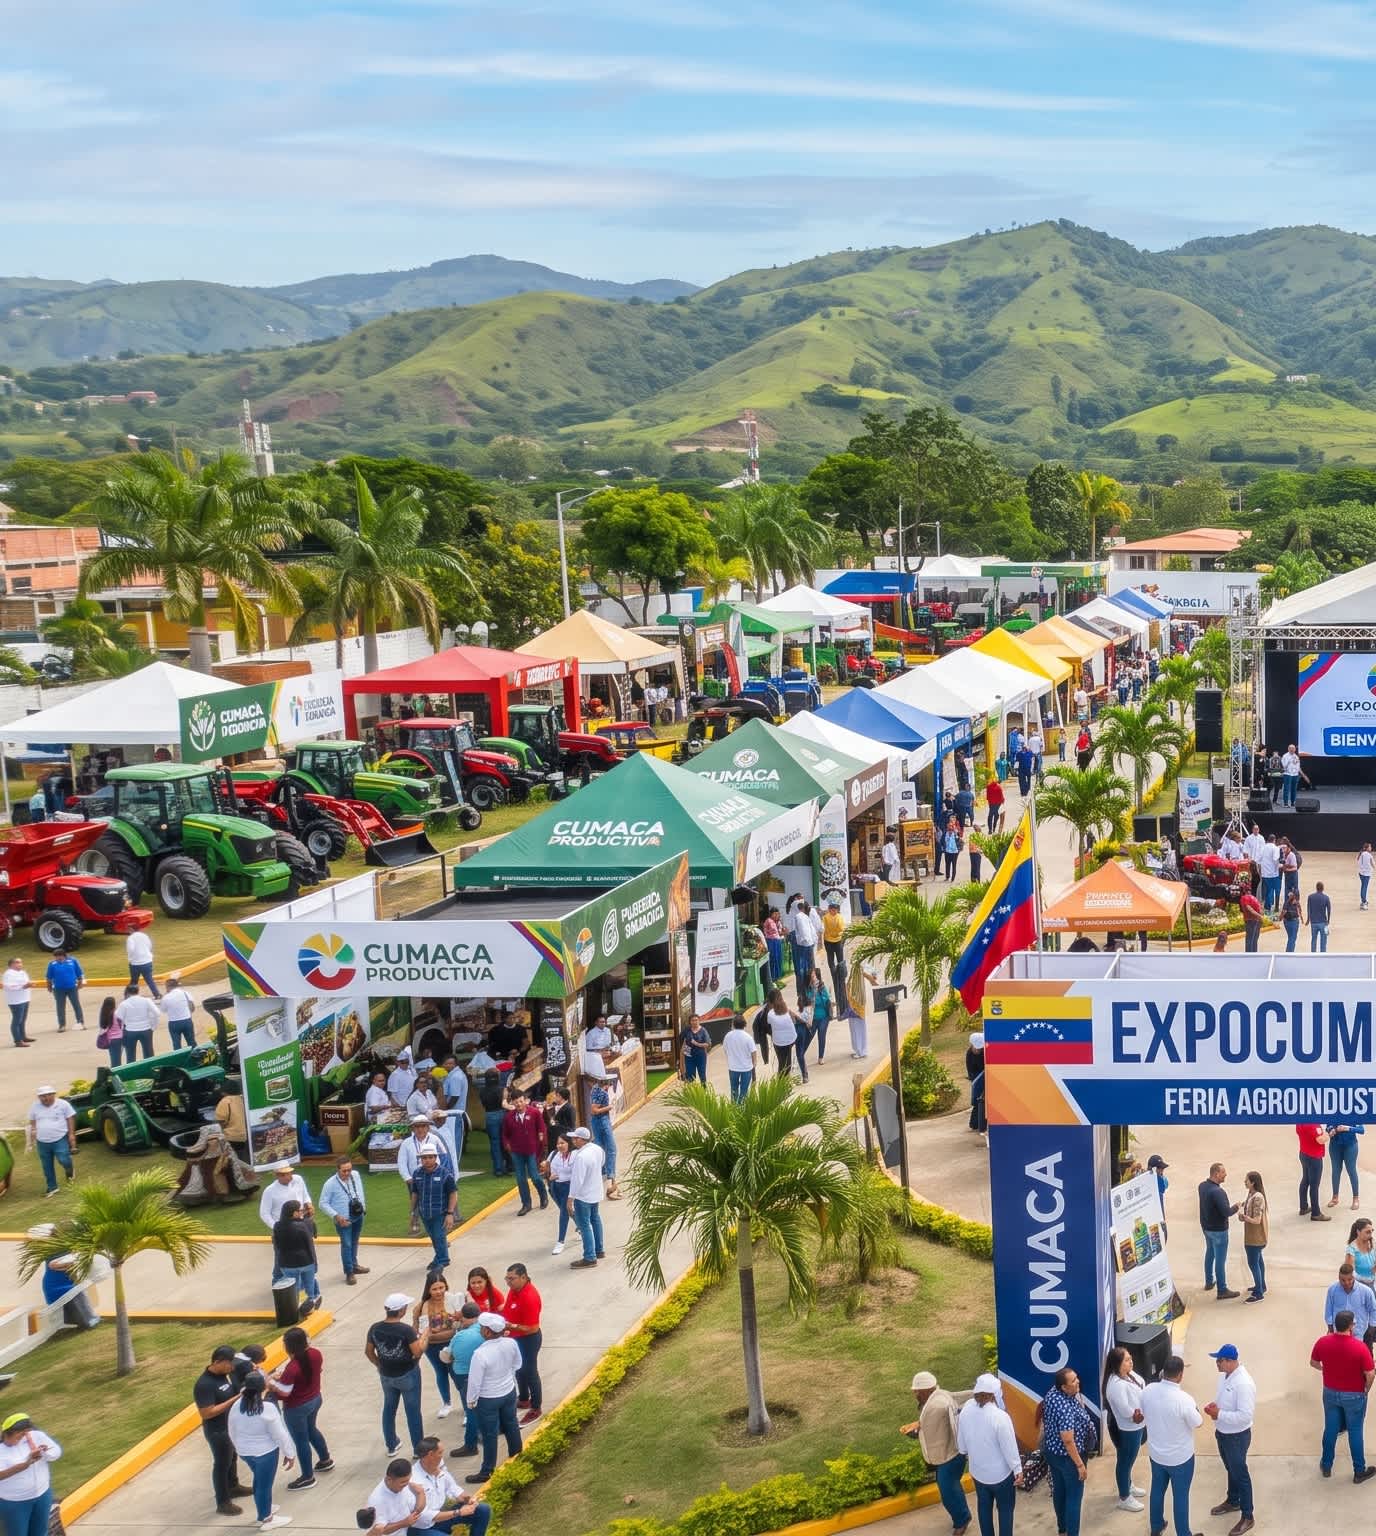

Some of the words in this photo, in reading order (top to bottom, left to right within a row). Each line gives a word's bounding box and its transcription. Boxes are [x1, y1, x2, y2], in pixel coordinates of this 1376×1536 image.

[220, 703, 264, 724] CUMACA
[553, 820, 665, 836] CUMACA
[363, 943, 493, 965] CUMACA
[366, 967, 495, 981] PRODUCTIVA
[1165, 1088, 1231, 1116] FERIA
[1024, 1151, 1070, 1373] CUMACA
